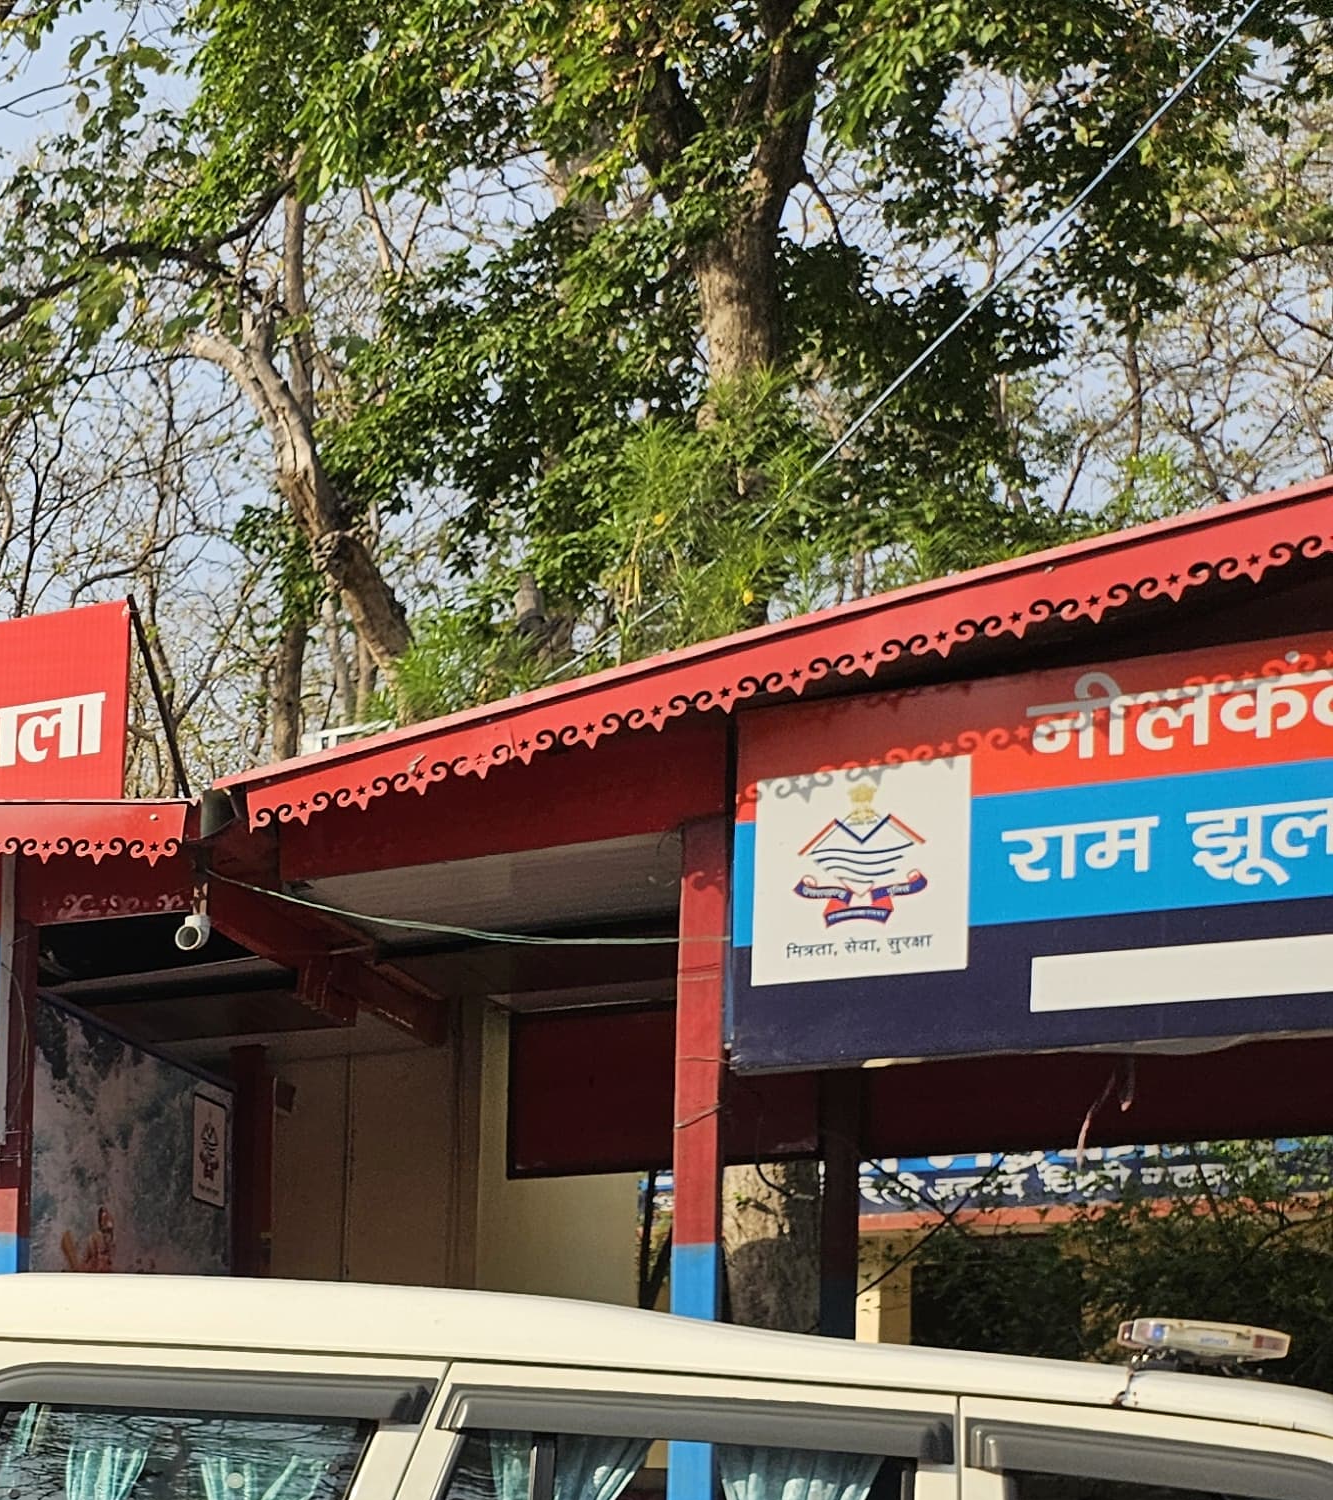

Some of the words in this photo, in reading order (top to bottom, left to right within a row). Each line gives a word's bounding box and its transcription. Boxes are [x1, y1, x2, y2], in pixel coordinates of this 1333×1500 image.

[1002, 815, 1160, 882] राम
[1186, 797, 1333, 885] झूल
[786, 942, 837, 959] मित्रता,
[844, 937, 880, 953] सेवा,
[887, 934, 933, 955] सुरक्षा
